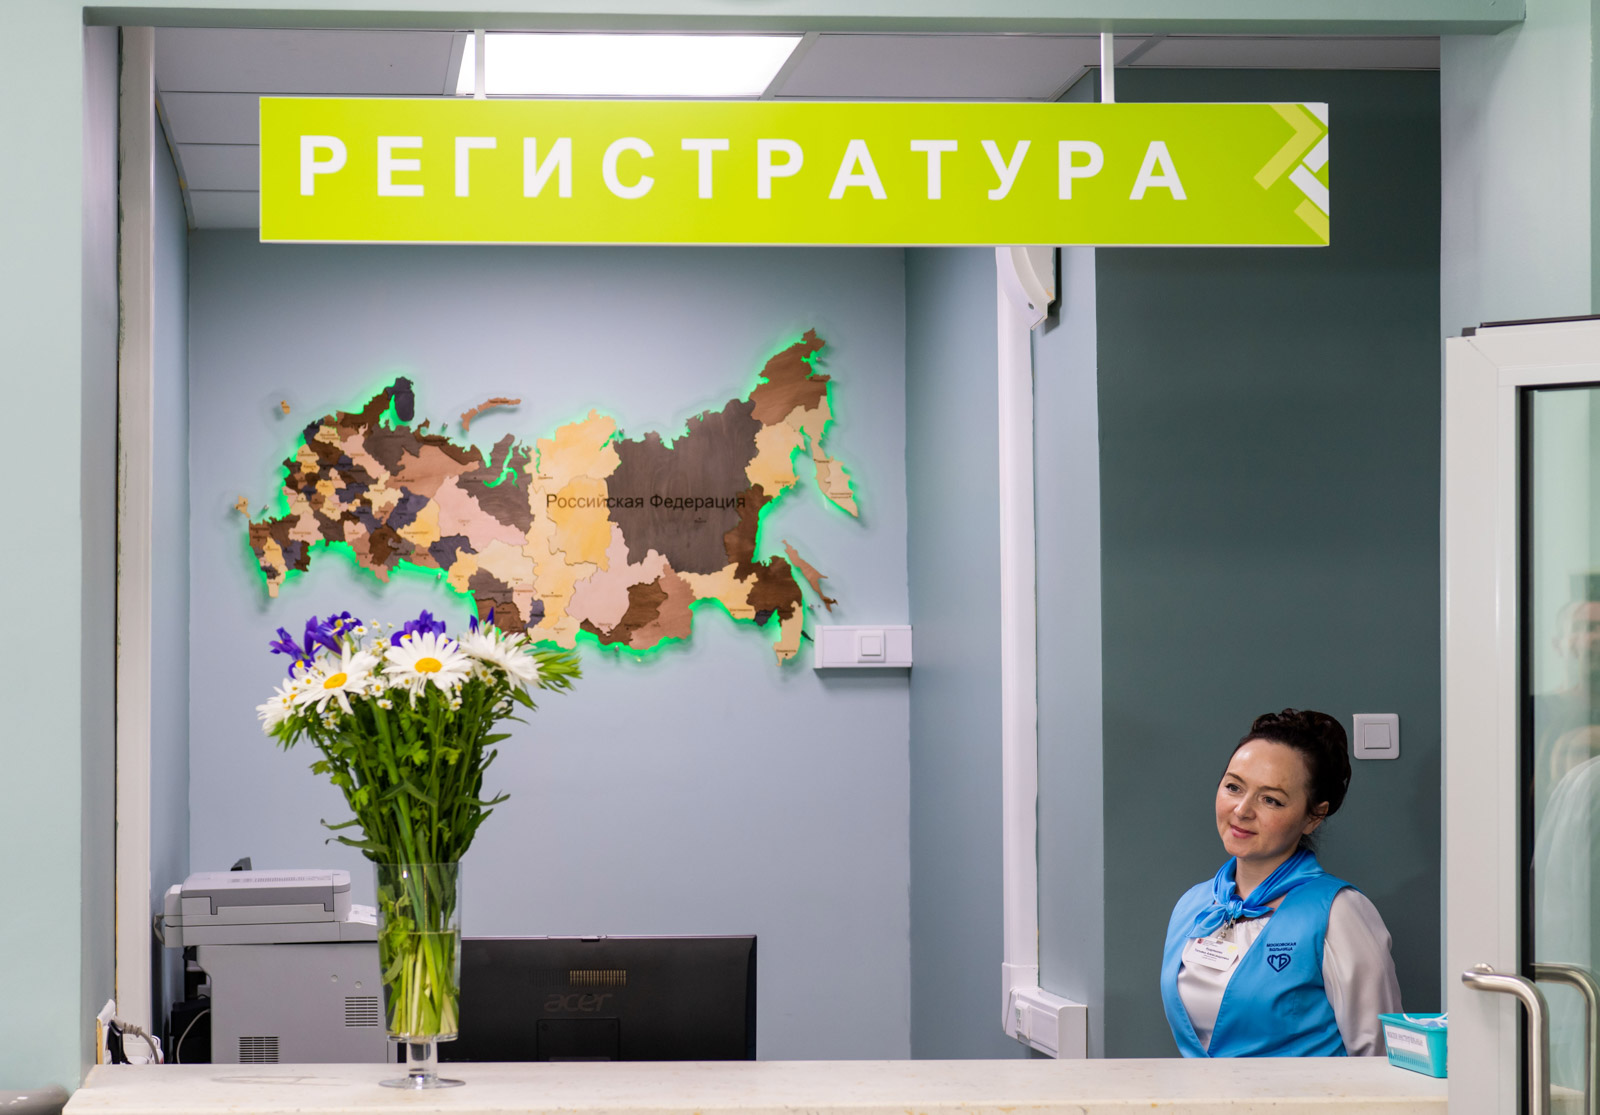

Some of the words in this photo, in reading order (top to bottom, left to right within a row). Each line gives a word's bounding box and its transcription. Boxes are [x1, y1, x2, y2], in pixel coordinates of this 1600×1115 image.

[300, 135, 1187, 200] РЕГИСТРАТУРА
[546, 493, 644, 509] Российская
[649, 493, 746, 511] Федерация
[544, 993, 613, 1012] acer
